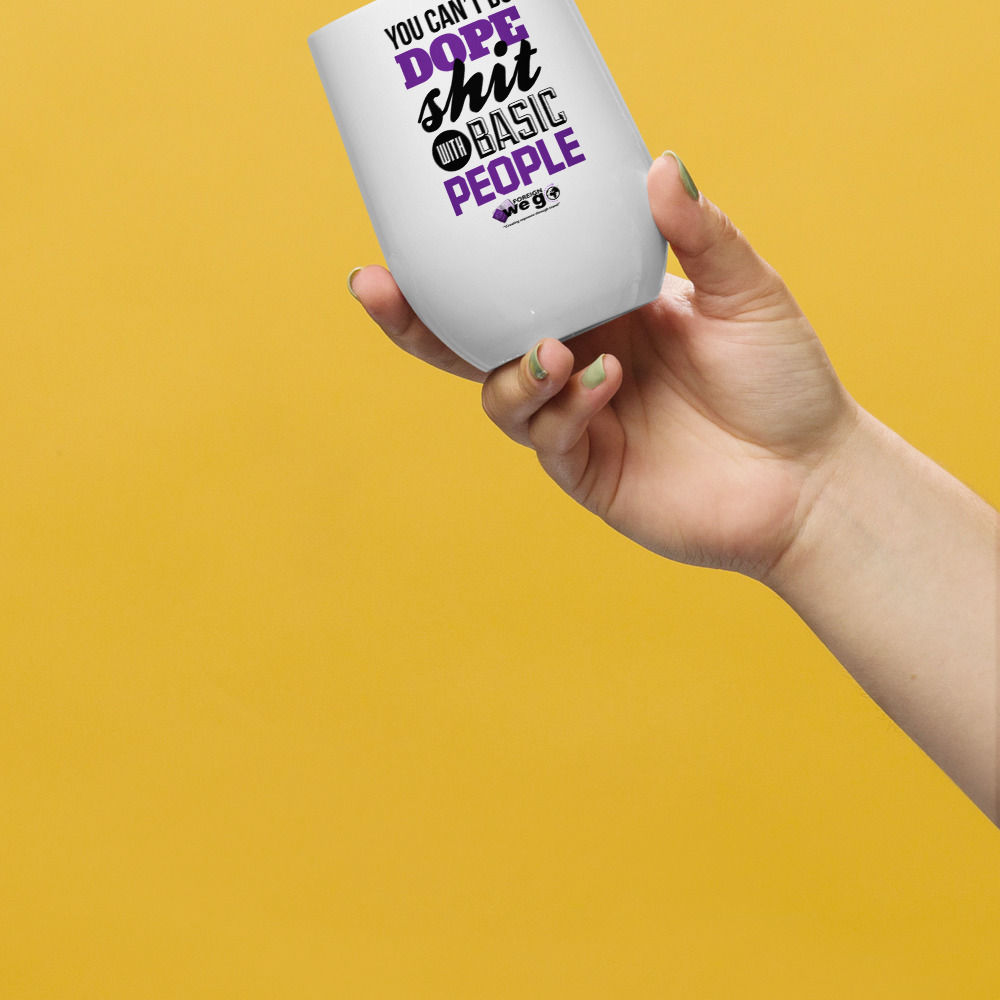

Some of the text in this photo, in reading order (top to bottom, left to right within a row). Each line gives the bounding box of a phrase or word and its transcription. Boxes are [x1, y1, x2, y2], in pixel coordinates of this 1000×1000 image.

[384, 16, 424, 50] YOU
[394, 5, 529, 89] DOPE
[417, 39, 541, 133] shit
[435, 87, 567, 166] WITH BASIC
[443, 127, 586, 216] PEOPLE
[512, 188, 543, 204] FOREIGN
